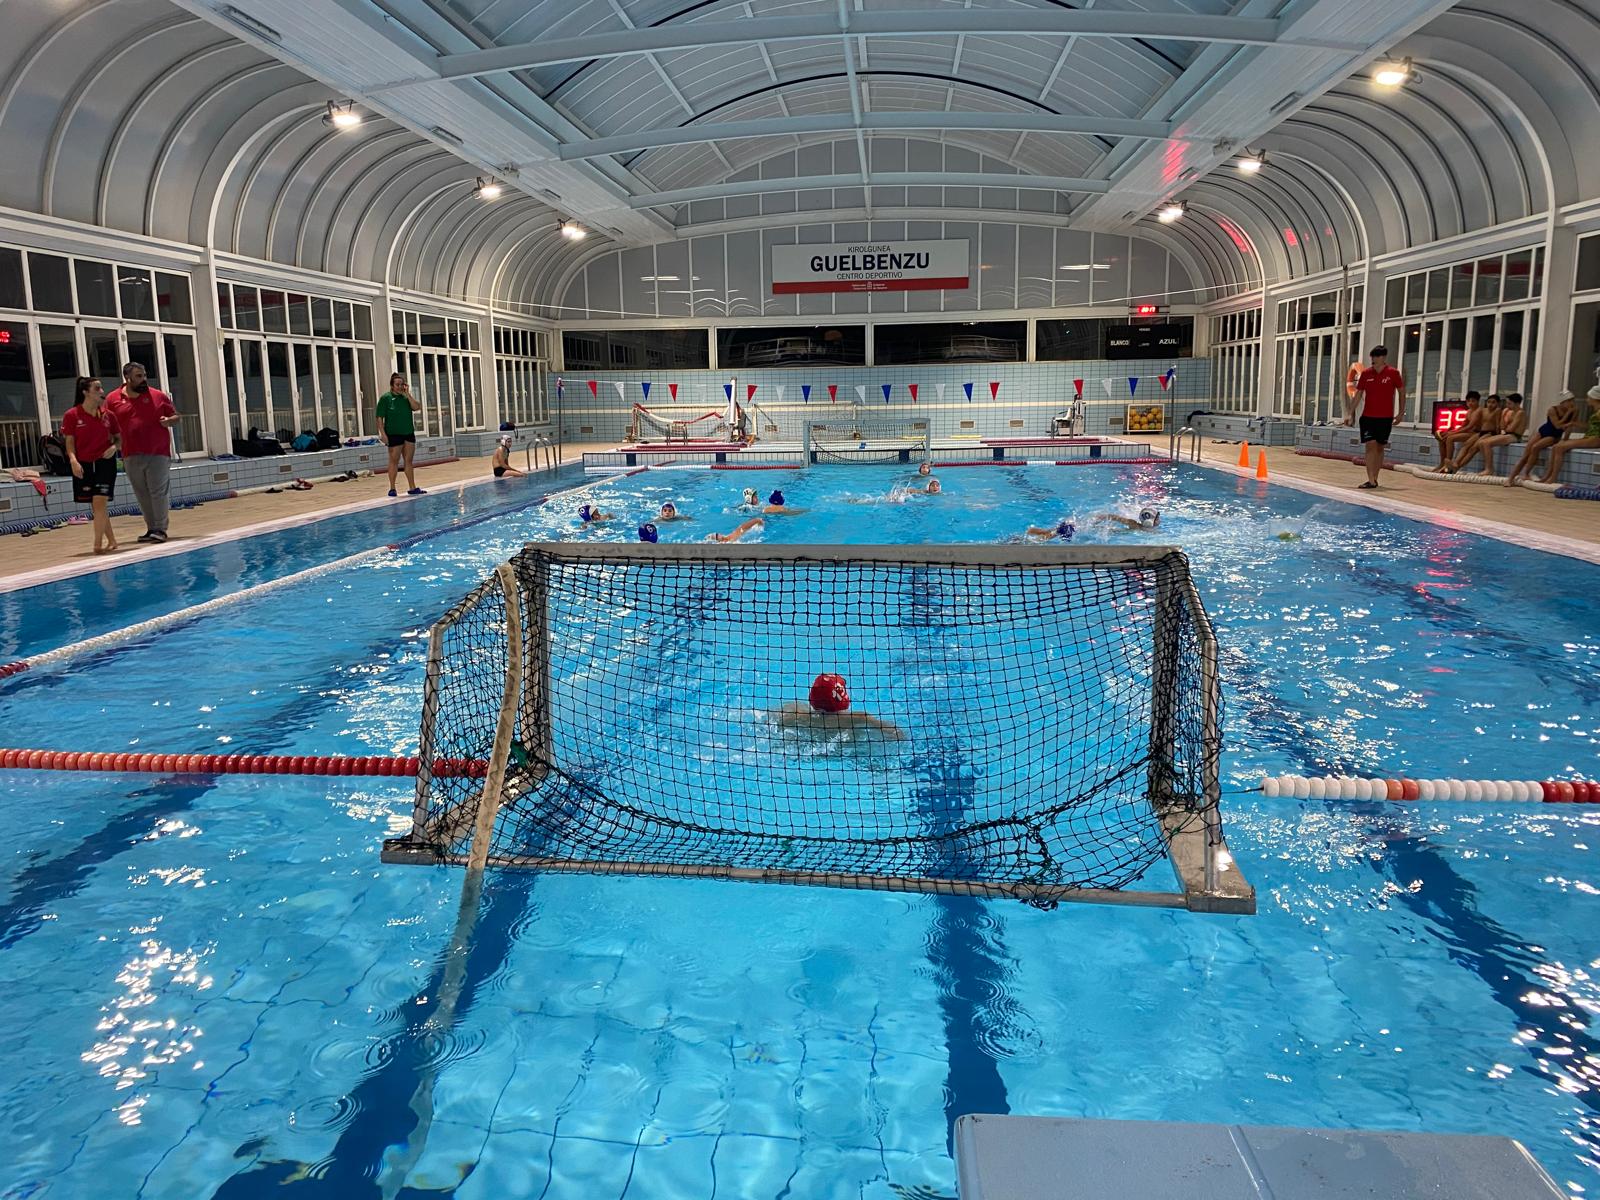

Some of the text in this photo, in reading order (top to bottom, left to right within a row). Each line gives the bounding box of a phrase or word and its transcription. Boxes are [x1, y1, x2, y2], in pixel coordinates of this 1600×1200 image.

[848, 245, 891, 253] KIROLGUNEA
[810, 252, 930, 272] GUELBENZU
[836, 271, 903, 280] CENTRO DEPORTIVO
